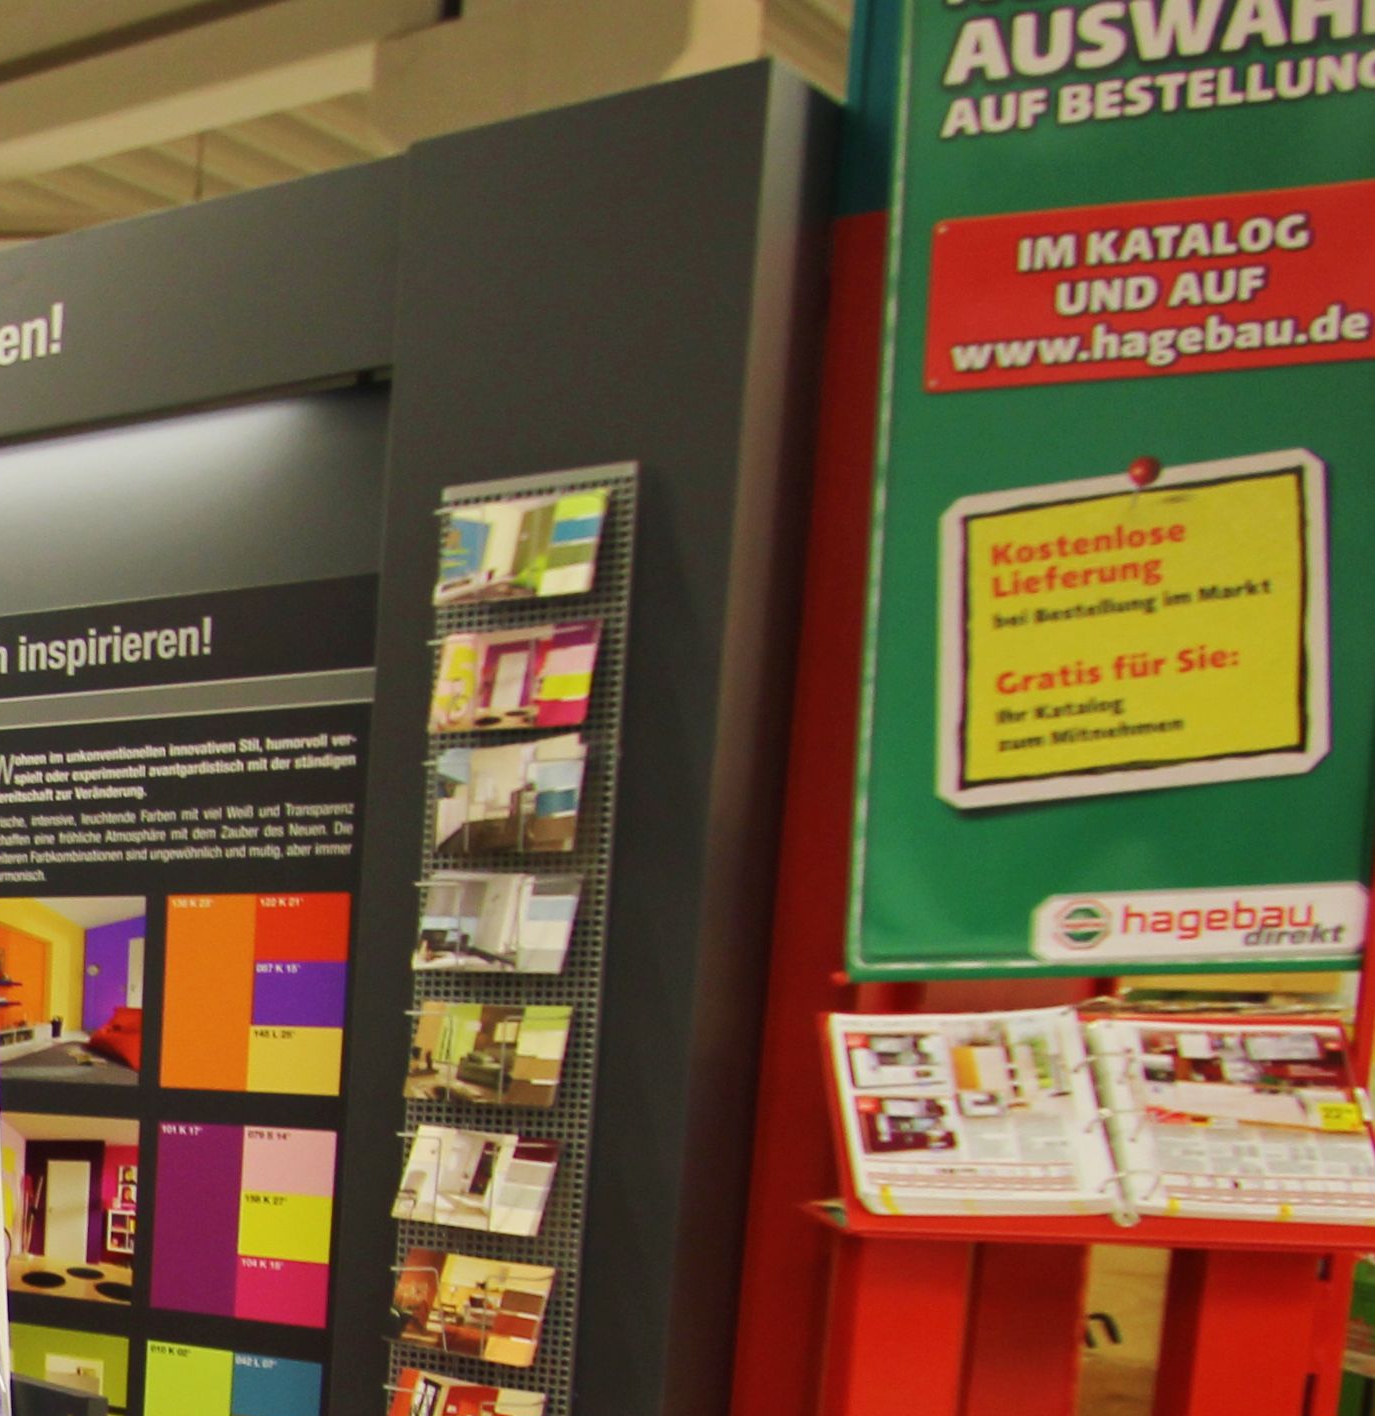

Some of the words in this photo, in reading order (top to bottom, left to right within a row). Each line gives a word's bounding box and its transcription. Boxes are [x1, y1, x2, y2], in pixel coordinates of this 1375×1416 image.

[943, 0, 1375, 85] AUSWAH
[940, 89, 1048, 138] AUF
[1017, 234, 1077, 272] IM
[1085, 213, 1311, 266] KATALOG
[1055, 275, 1159, 316] UND
[1168, 266, 1267, 307] AUF
[950, 304, 1371, 372] www.hagebau.de
[990, 522, 1187, 567] Kostenlose
[991, 558, 1163, 598] Lieferung
[992, 608, 1029, 629] bei
[1033, 595, 1157, 624] Bestellung
[1163, 589, 1191, 608] im
[1198, 578, 1272, 603] Markt
[18, 616, 213, 677] inspirieren!
[995, 665, 1102, 696] Gratis
[1113, 655, 1164, 683] für
[1177, 645, 1240, 674] Sie:
[996, 707, 1028, 726] Ihr
[1034, 696, 1125, 722] Katalog
[997, 734, 1044, 752] zum
[1050, 717, 1184, 747] Mitnehmen
[247, 758, 267, 772] mit
[270, 758, 291, 770] der
[265, 733, 328, 751] humorvoll
[1120, 899, 1315, 940] hagebau
[1242, 923, 1346, 949] direkt
